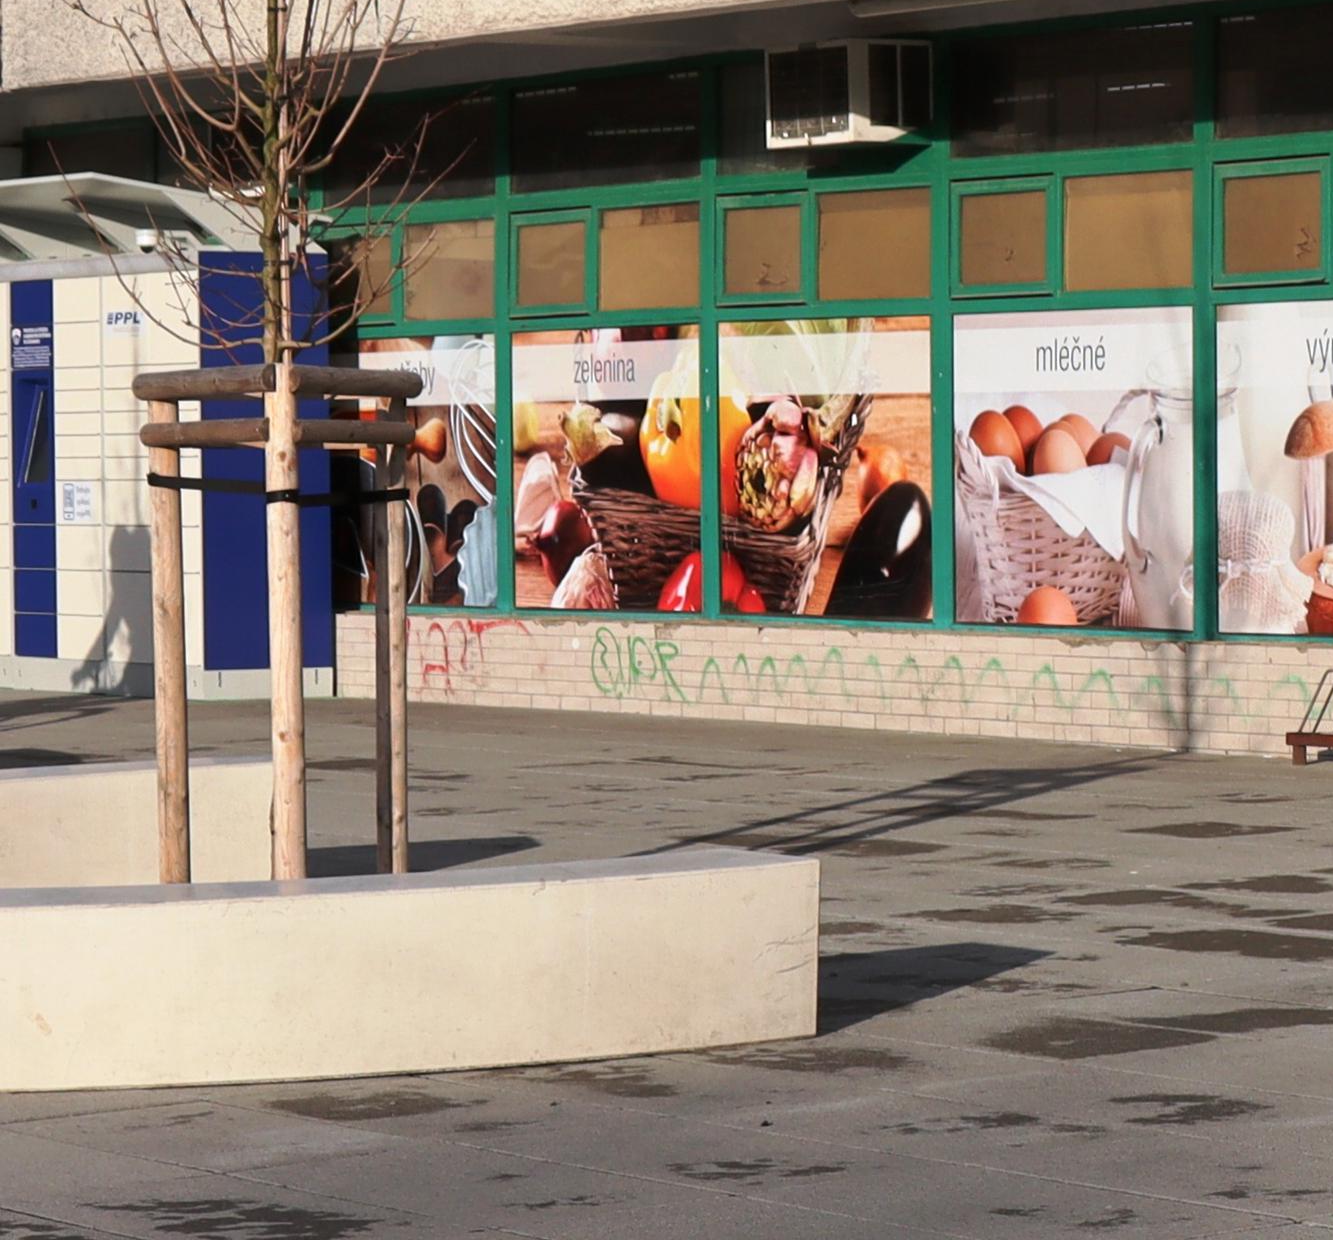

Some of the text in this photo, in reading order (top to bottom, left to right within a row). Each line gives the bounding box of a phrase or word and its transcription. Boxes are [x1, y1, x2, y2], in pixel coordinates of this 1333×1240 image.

[114, 312, 140, 325] PPL
[573, 353, 636, 385] zelenina
[1035, 335, 1106, 373] mléčné
